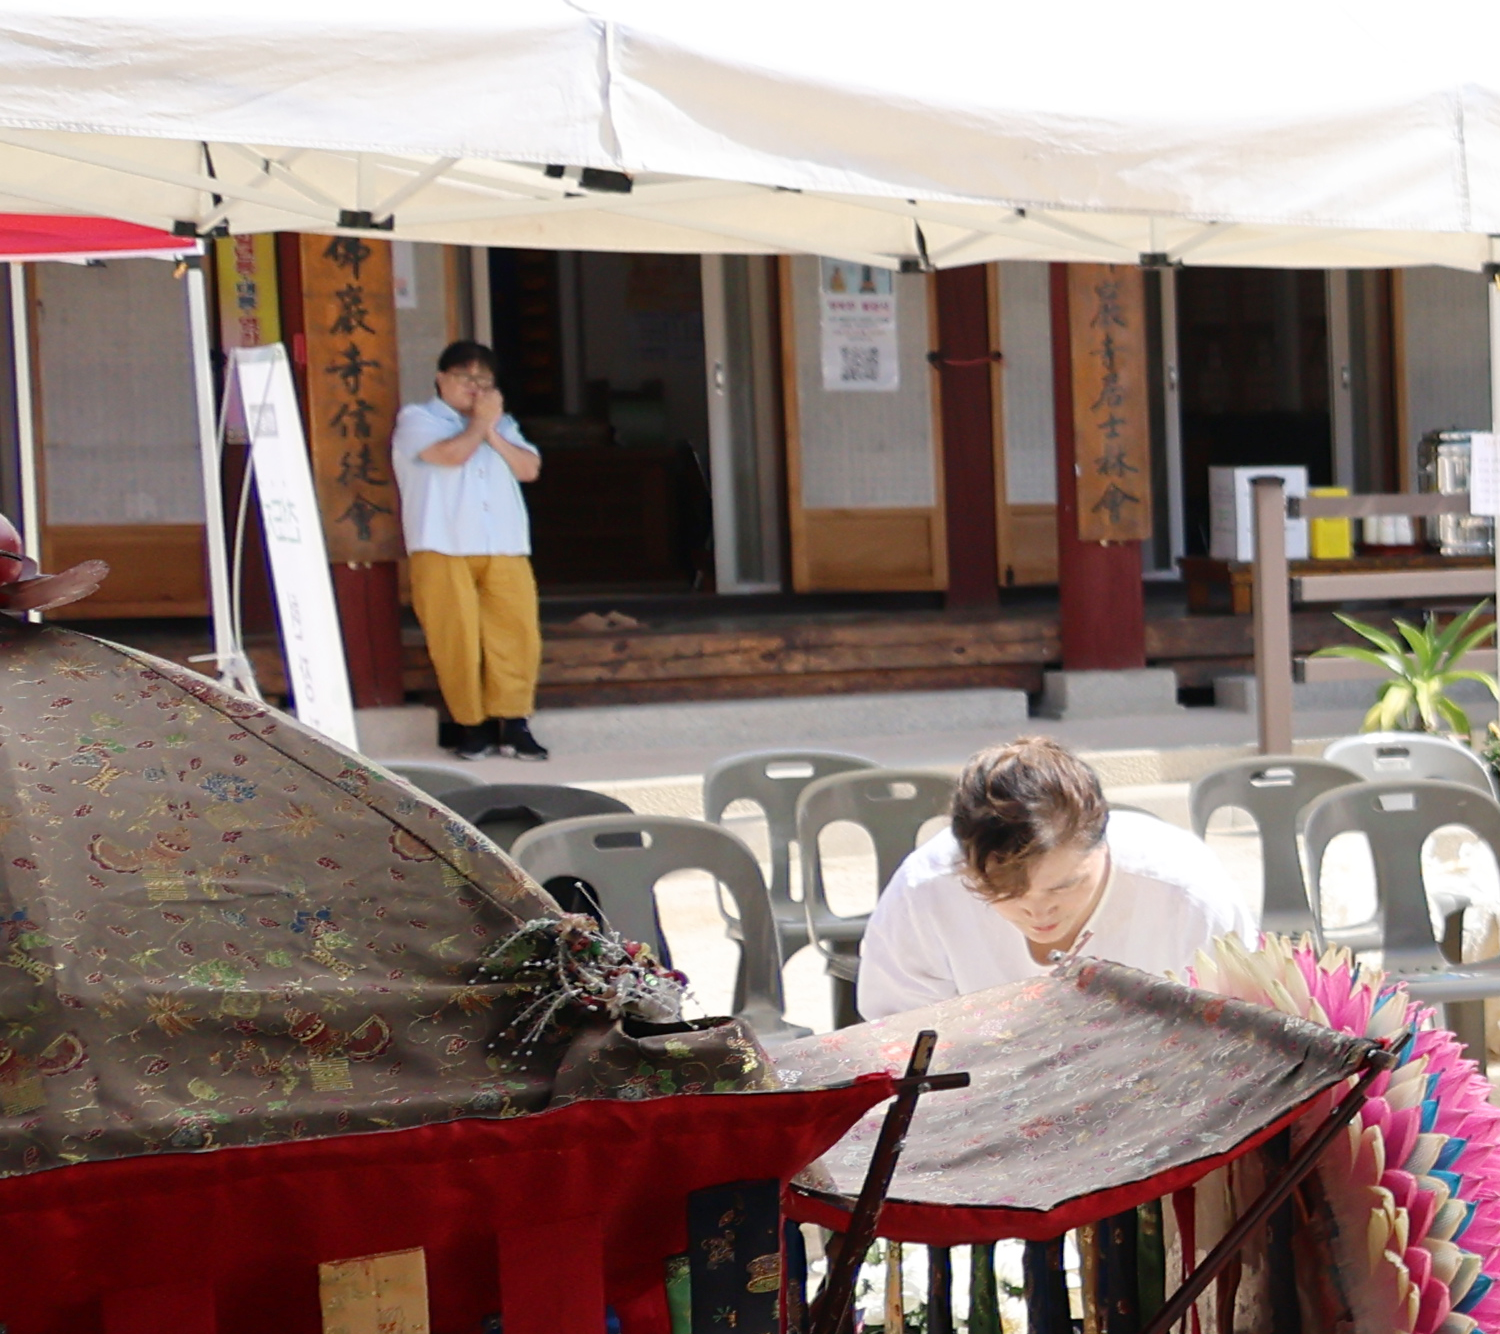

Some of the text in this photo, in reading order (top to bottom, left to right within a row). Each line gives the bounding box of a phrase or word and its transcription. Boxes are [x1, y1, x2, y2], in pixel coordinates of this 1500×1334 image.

[1090, 264, 1140, 524] 巖寺居士林會
